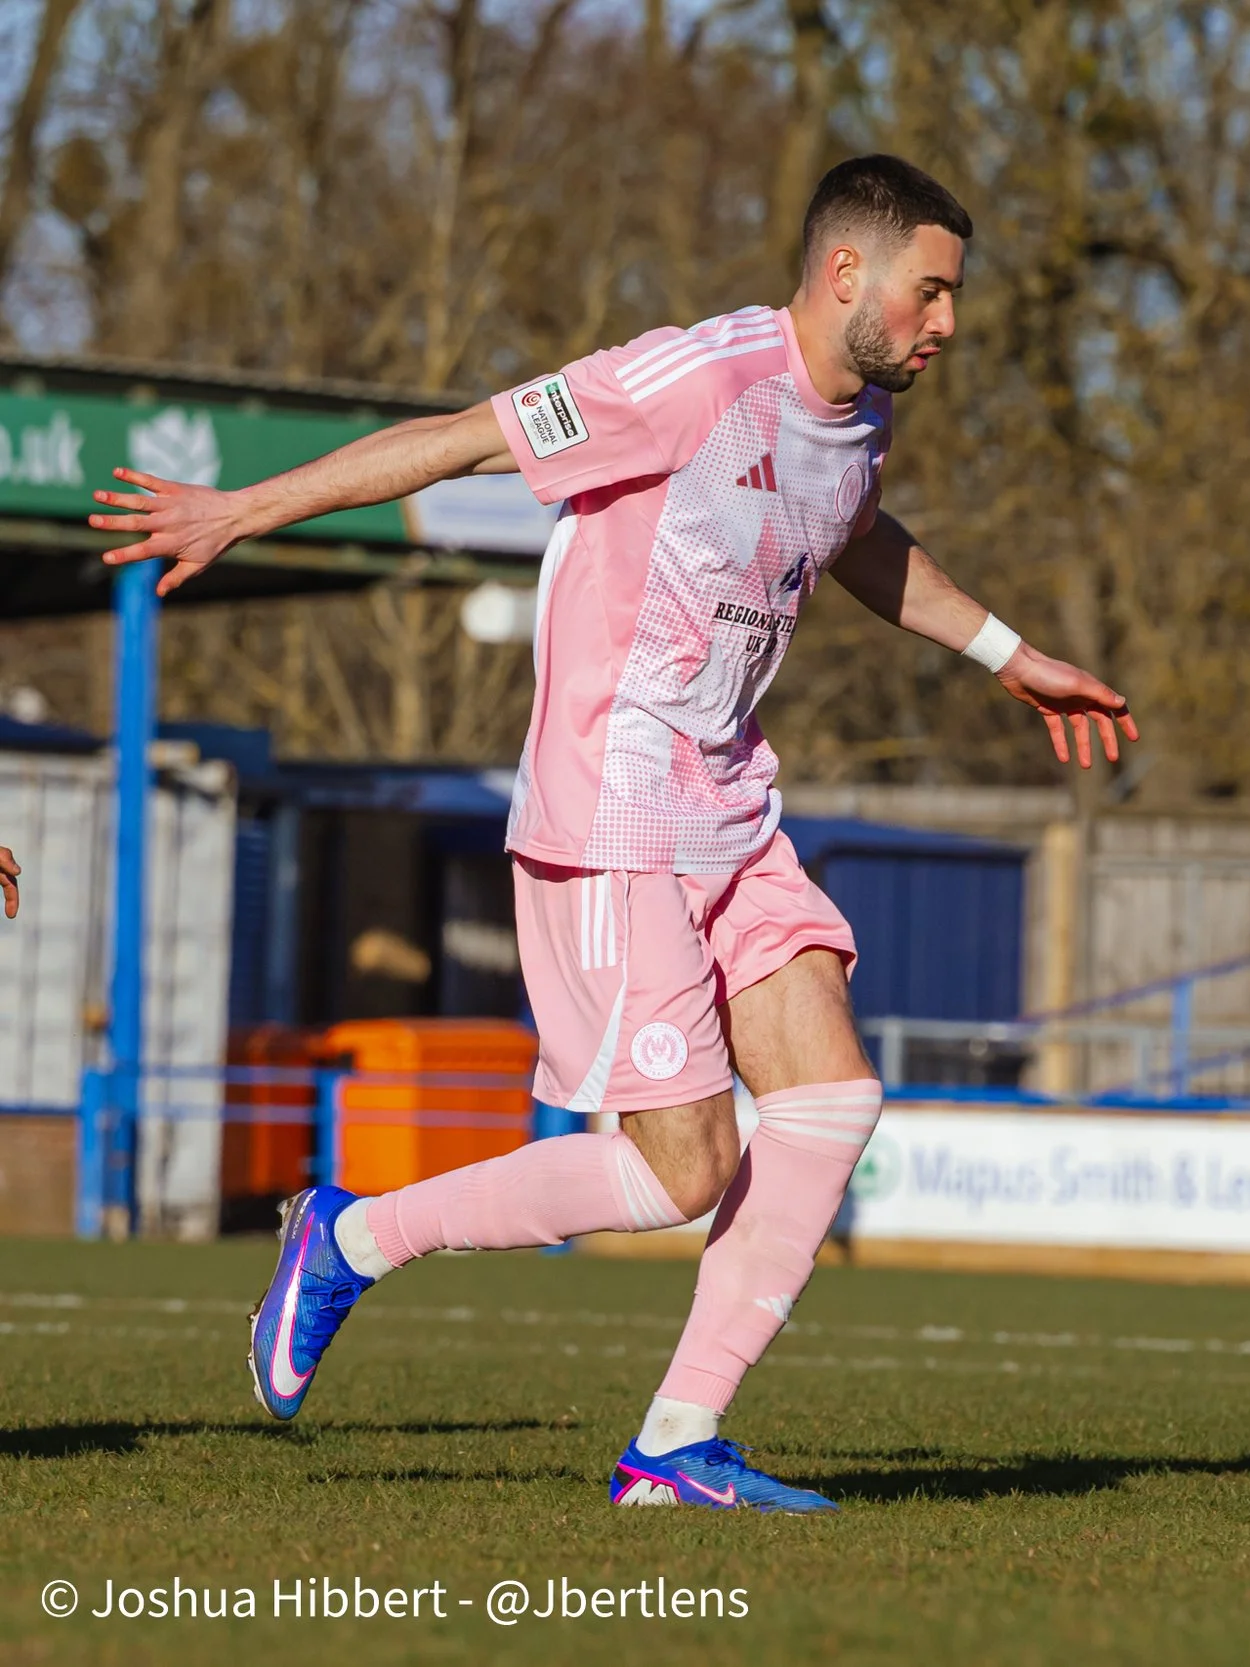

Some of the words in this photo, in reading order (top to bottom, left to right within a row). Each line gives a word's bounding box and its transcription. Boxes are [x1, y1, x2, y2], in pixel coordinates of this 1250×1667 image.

[531, 413, 549, 444] LEAGUE
[536, 405, 558, 446] NATIONAL
[1051, 1143, 1160, 1206] Smith
[1169, 1149, 1199, 1211] &
